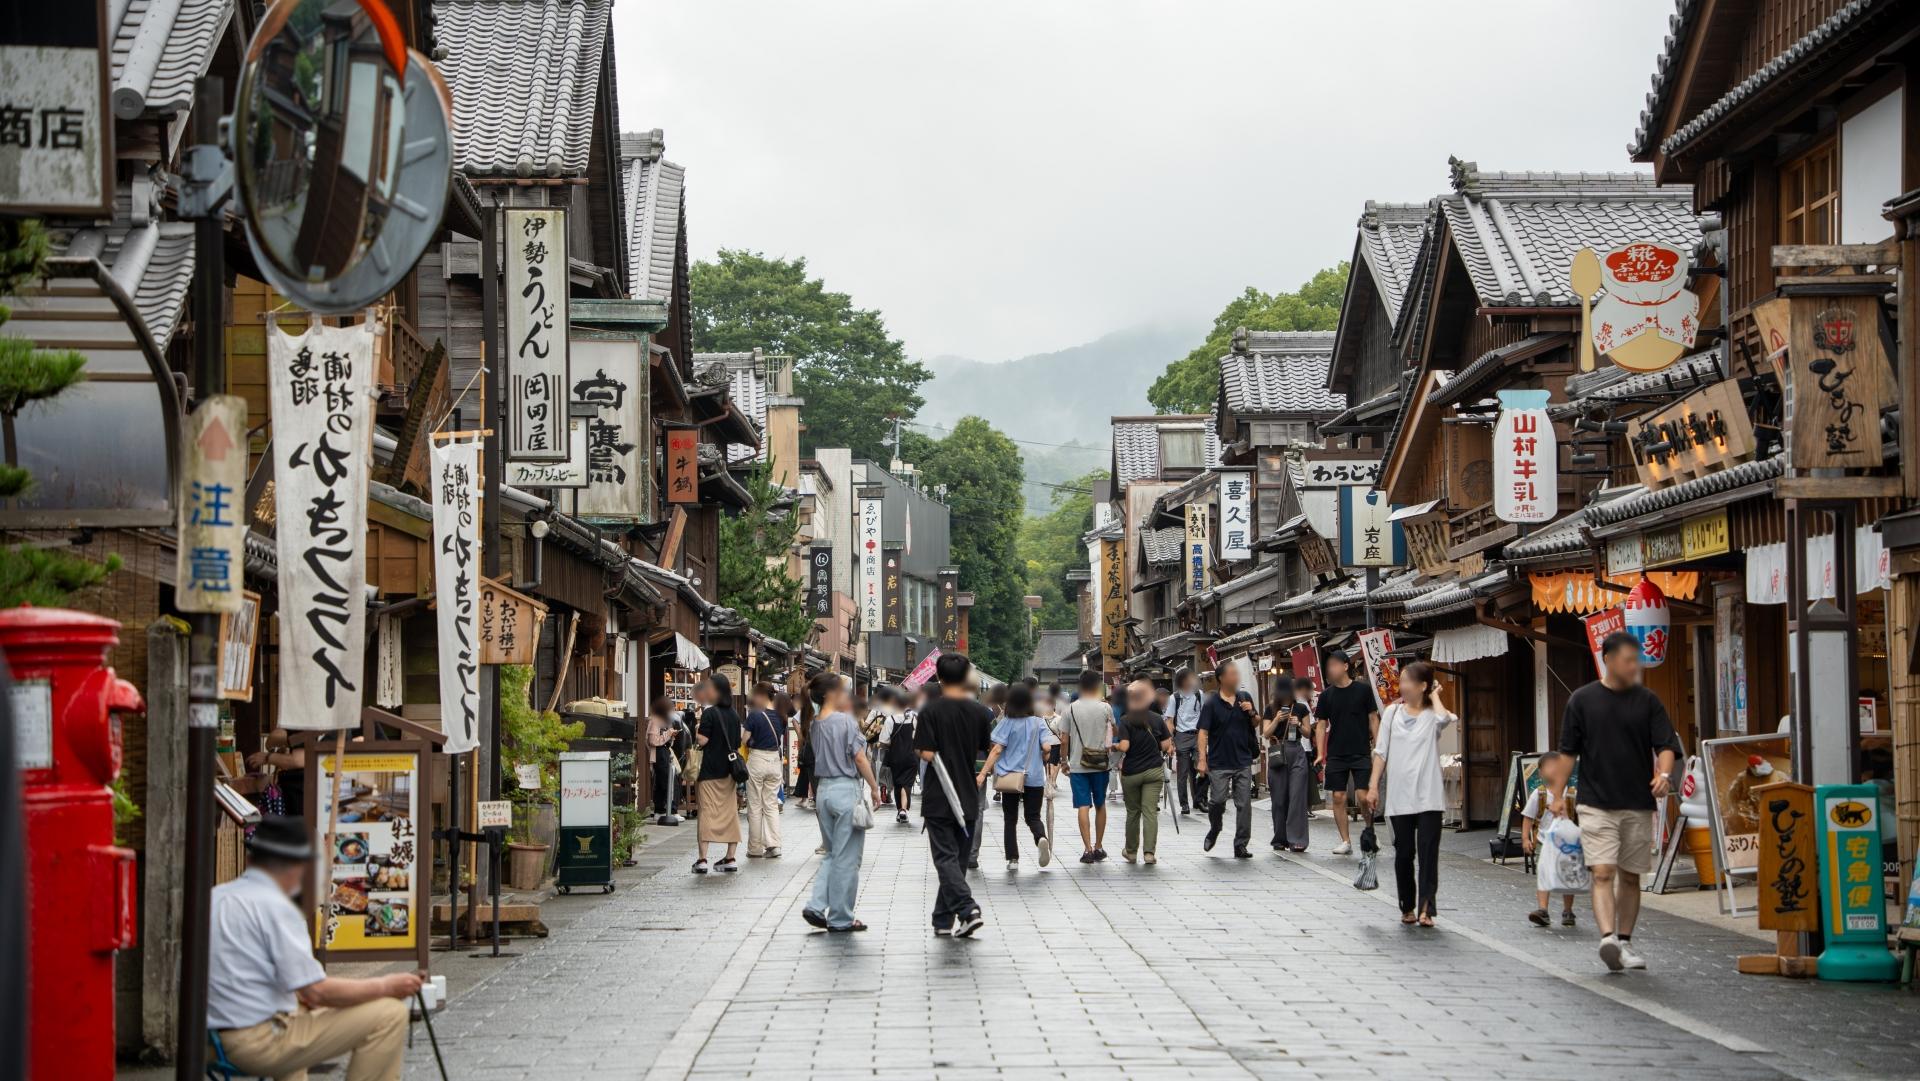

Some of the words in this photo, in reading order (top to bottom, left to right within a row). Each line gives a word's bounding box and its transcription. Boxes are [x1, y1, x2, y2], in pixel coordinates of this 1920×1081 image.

[0, 103, 84, 149] 商店
[1614, 259, 1671, 274] ぷりん
[519, 216, 550, 359] 伊勢うどん
[523, 372, 551, 451] 岡田屋
[516, 467, 579, 481] カップジュビー
[673, 455, 693, 493] 牛鍋
[1313, 464, 1379, 481] わらじや
[1513, 414, 1538, 502] 山村牛乳
[866, 503, 877, 537] ゑびや
[1224, 480, 1248, 550] 喜久屋
[188, 481, 233, 592] 注意
[1363, 526, 1381, 560] 岩座
[866, 555, 876, 576] 商店
[866, 597, 876, 628] 大食堂
[887, 575, 898, 629] 岩戸屋
[944, 595, 954, 642] 岩戸屋
[481, 603, 494, 643] もどる
[499, 599, 519, 656] おかげ横丁
[1642, 628, 1668, 659] 氷
[1727, 836, 1760, 853] ぷりん
[1845, 836, 1873, 909] 宅急便
